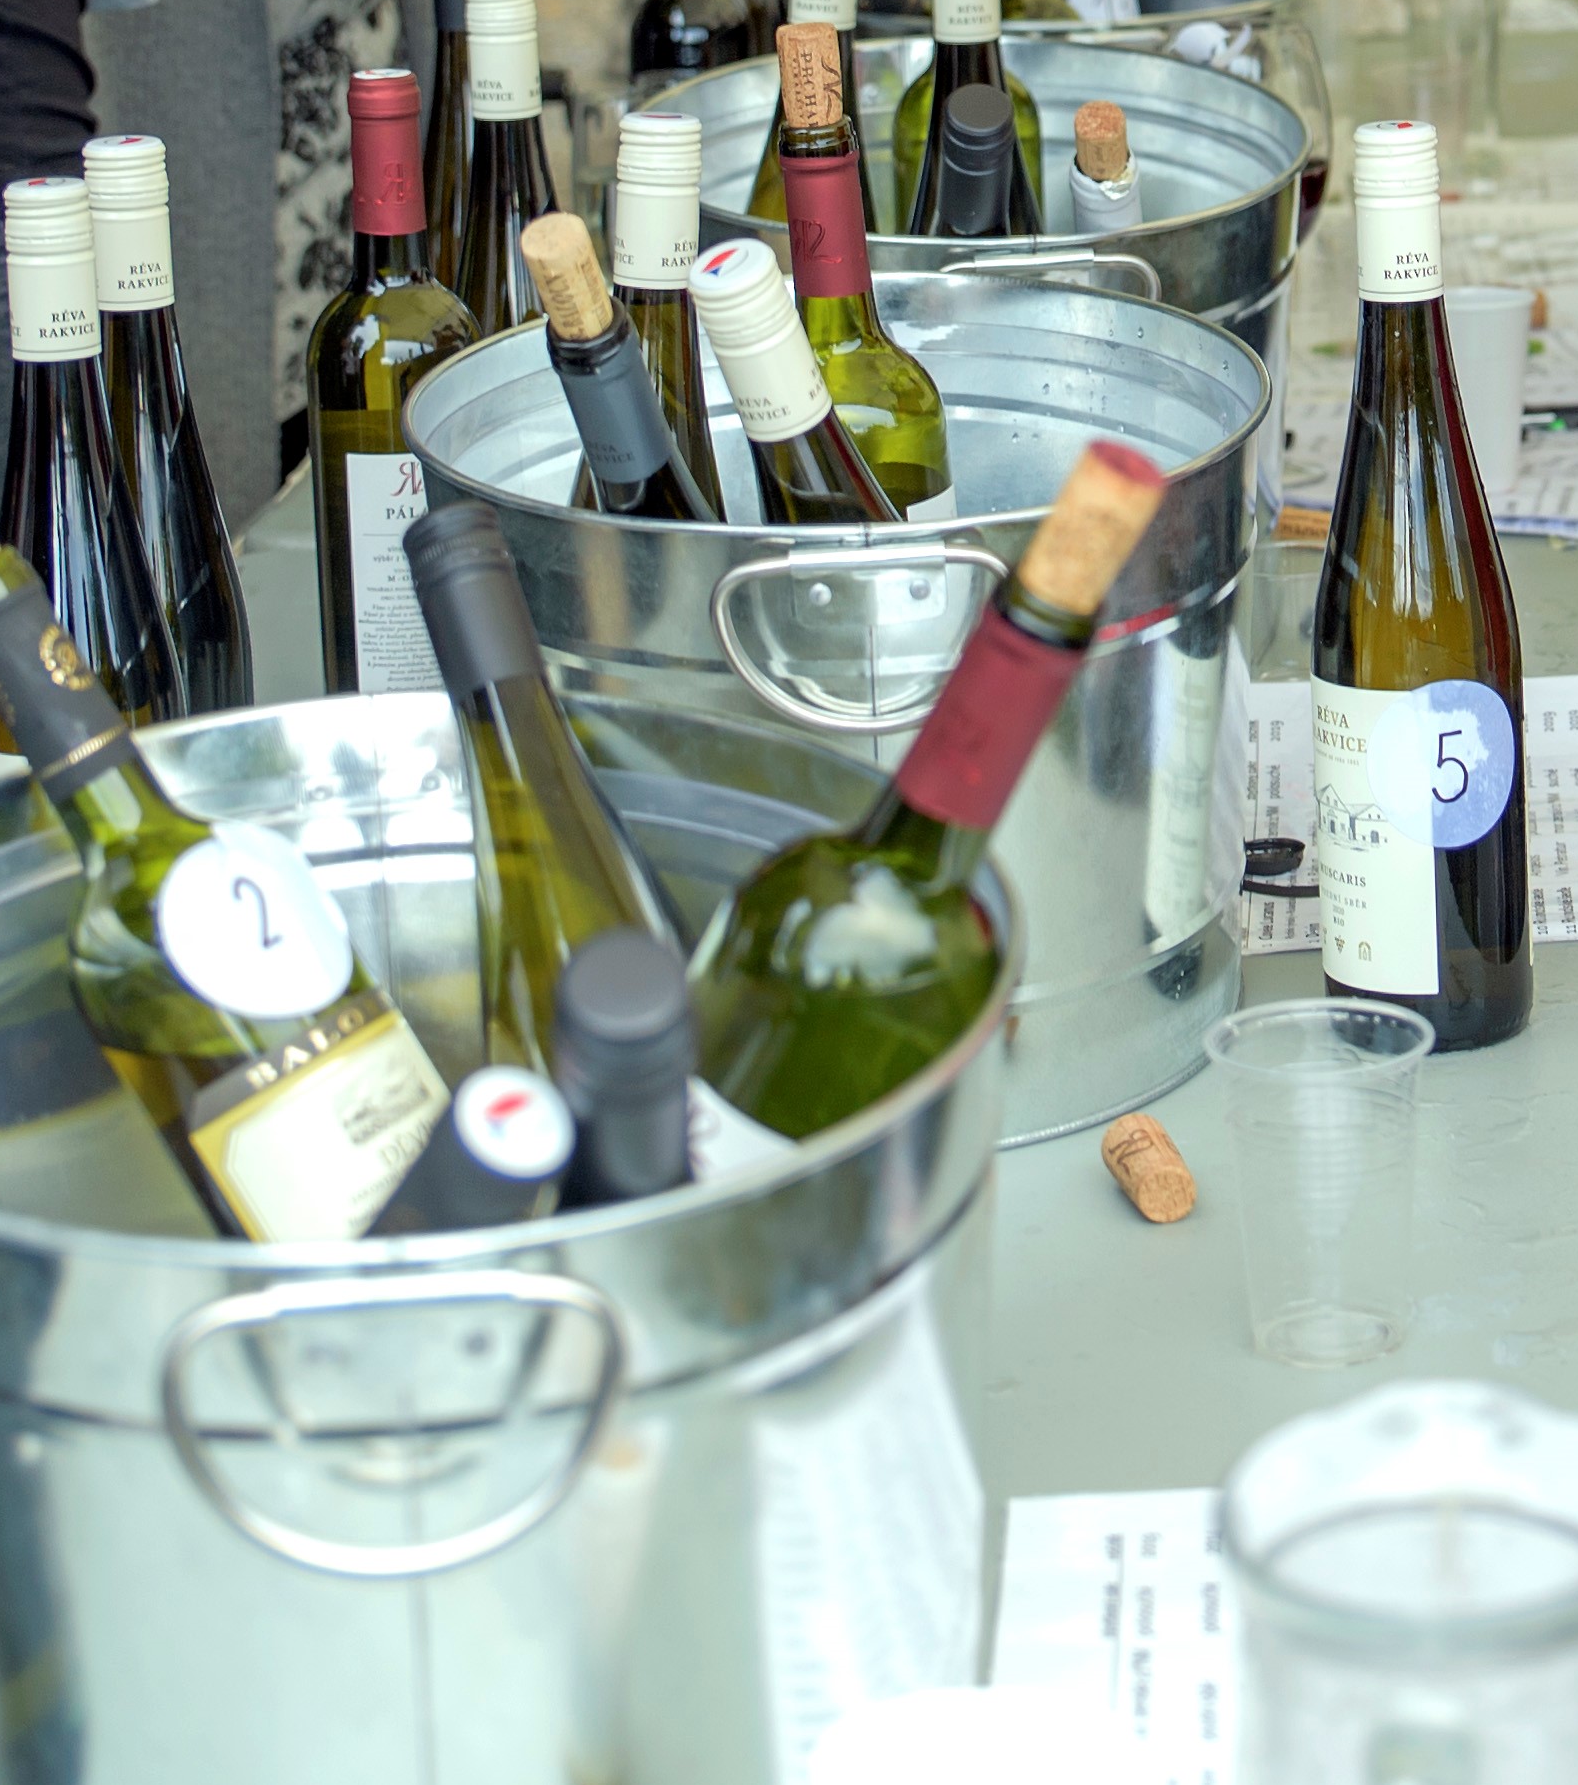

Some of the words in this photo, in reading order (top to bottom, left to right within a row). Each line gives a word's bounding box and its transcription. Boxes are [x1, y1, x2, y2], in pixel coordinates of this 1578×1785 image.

[477, 79, 503, 91] RÉVA
[1396, 252, 1430, 265] RÉVA
[130, 262, 162, 275] RÉVA
[1383, 265, 1440, 280] RAKVICE
[117, 274, 170, 291] RAKVICE
[51, 309, 87, 323] RÉVA
[39, 323, 96, 339] RAKVICE
[1317, 704, 1349, 728] RÉVA
[1543, 711, 1557, 732] 2019
[1269, 720, 1284, 742] 2019
[1431, 729, 1469, 804] 5
[233, 876, 283, 950] 2
[1564, 924, 1577, 934] 11
